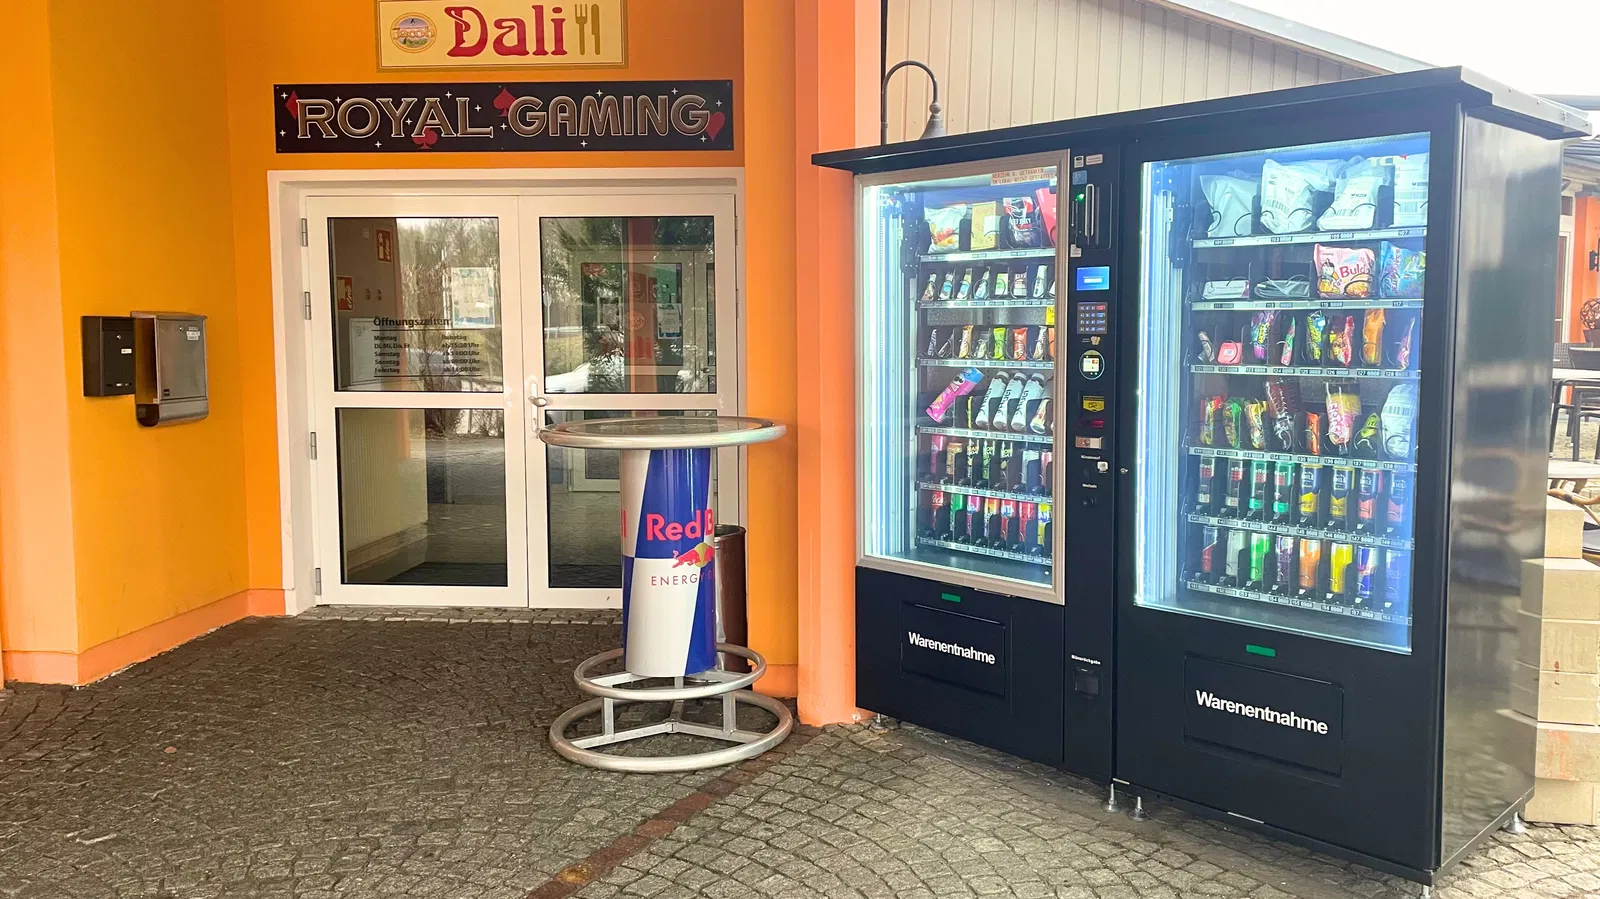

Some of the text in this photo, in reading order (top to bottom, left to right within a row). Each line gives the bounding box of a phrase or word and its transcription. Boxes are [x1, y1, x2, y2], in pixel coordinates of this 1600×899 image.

[445, 5, 567, 57] Dali
[296, 94, 711, 139] ROYAL GAMING
[373, 316, 452, 328] Öffnungszeiten
[646, 510, 702, 541] Red
[651, 573, 704, 586] ENERGY
[908, 631, 996, 665] Warenentnahme
[1196, 689, 1329, 736] Warenentnahme
